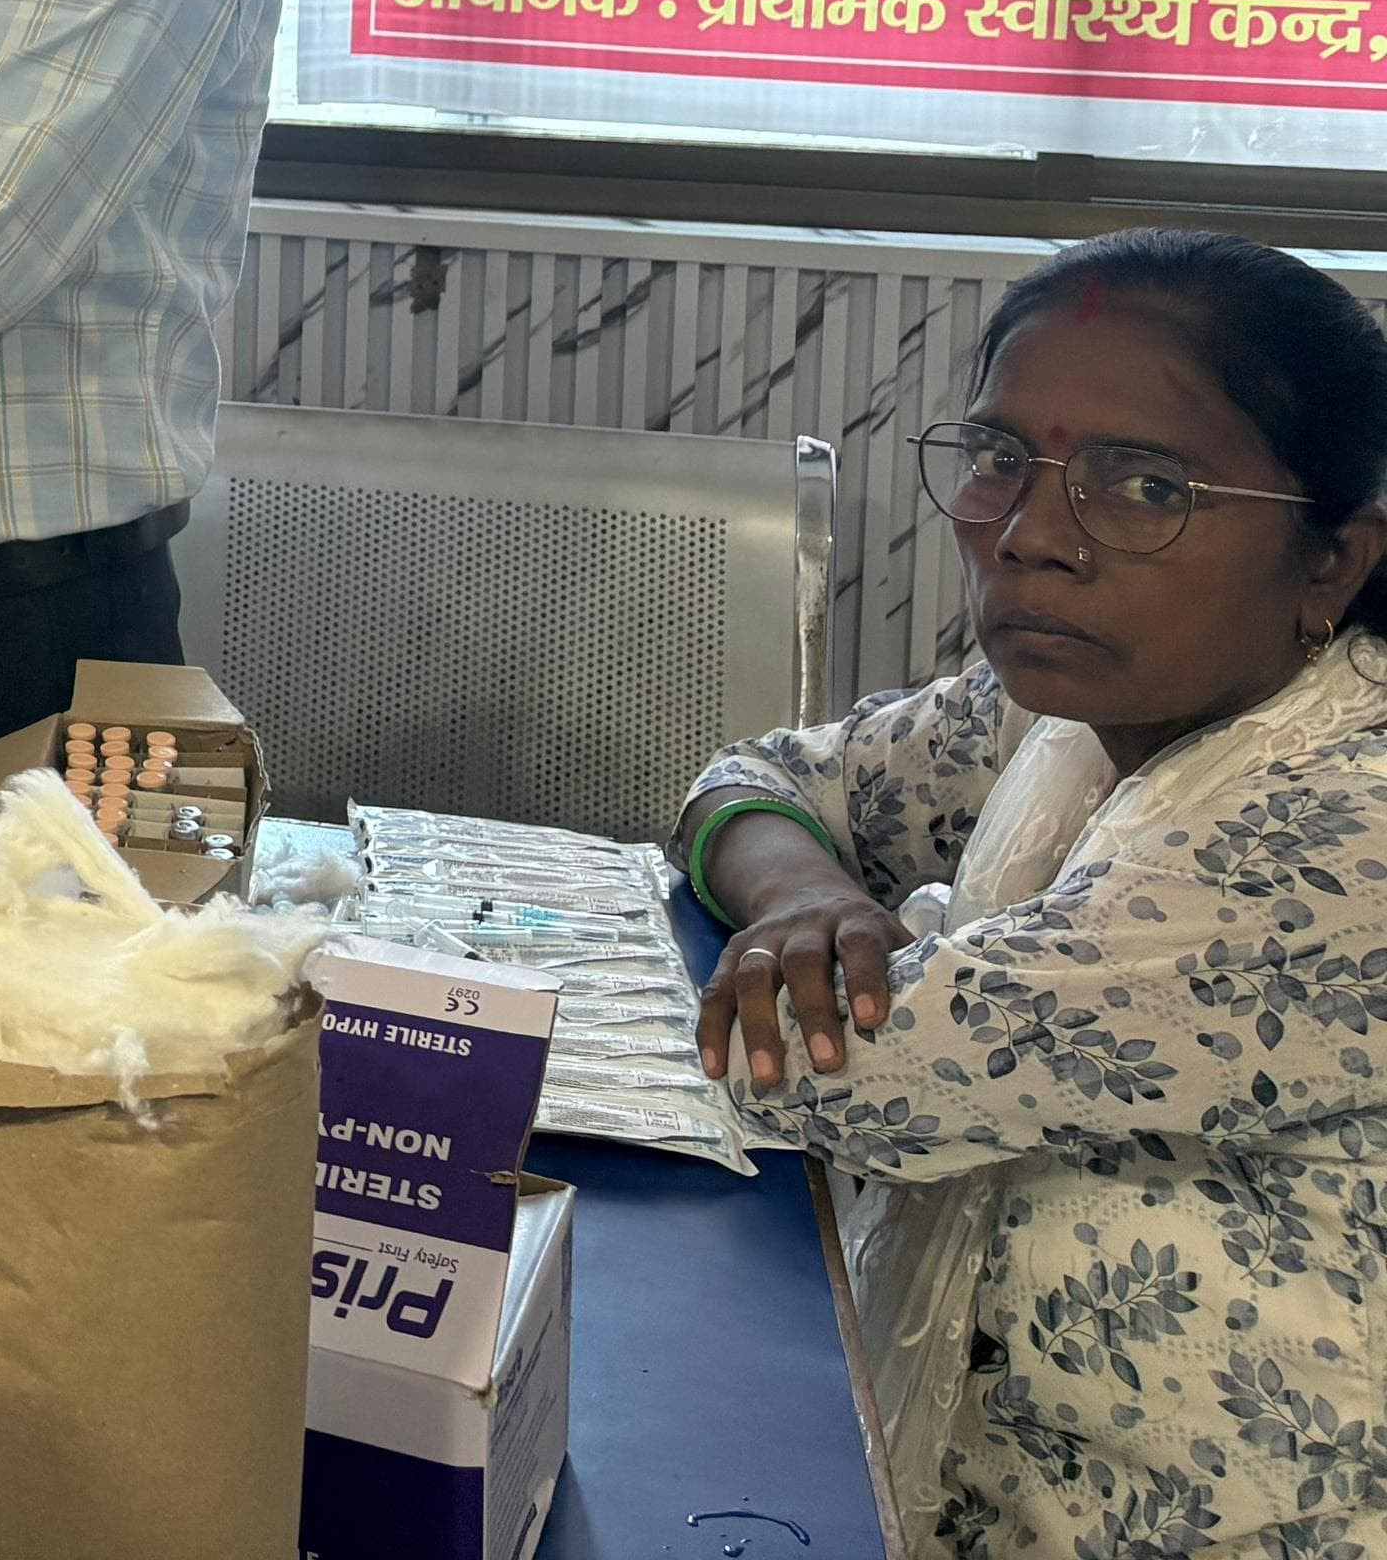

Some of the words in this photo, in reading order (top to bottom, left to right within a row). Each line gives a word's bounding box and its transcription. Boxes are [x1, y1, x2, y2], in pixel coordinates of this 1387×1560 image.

[447, 986, 481, 1001] 0297
[321, 1012, 379, 1040] HYPO
[385, 1025, 473, 1057] STERILE
[315, 1161, 443, 1211] STERIL
[413, 1246, 460, 1274] Safety
[312, 1249, 455, 1340] Pris
